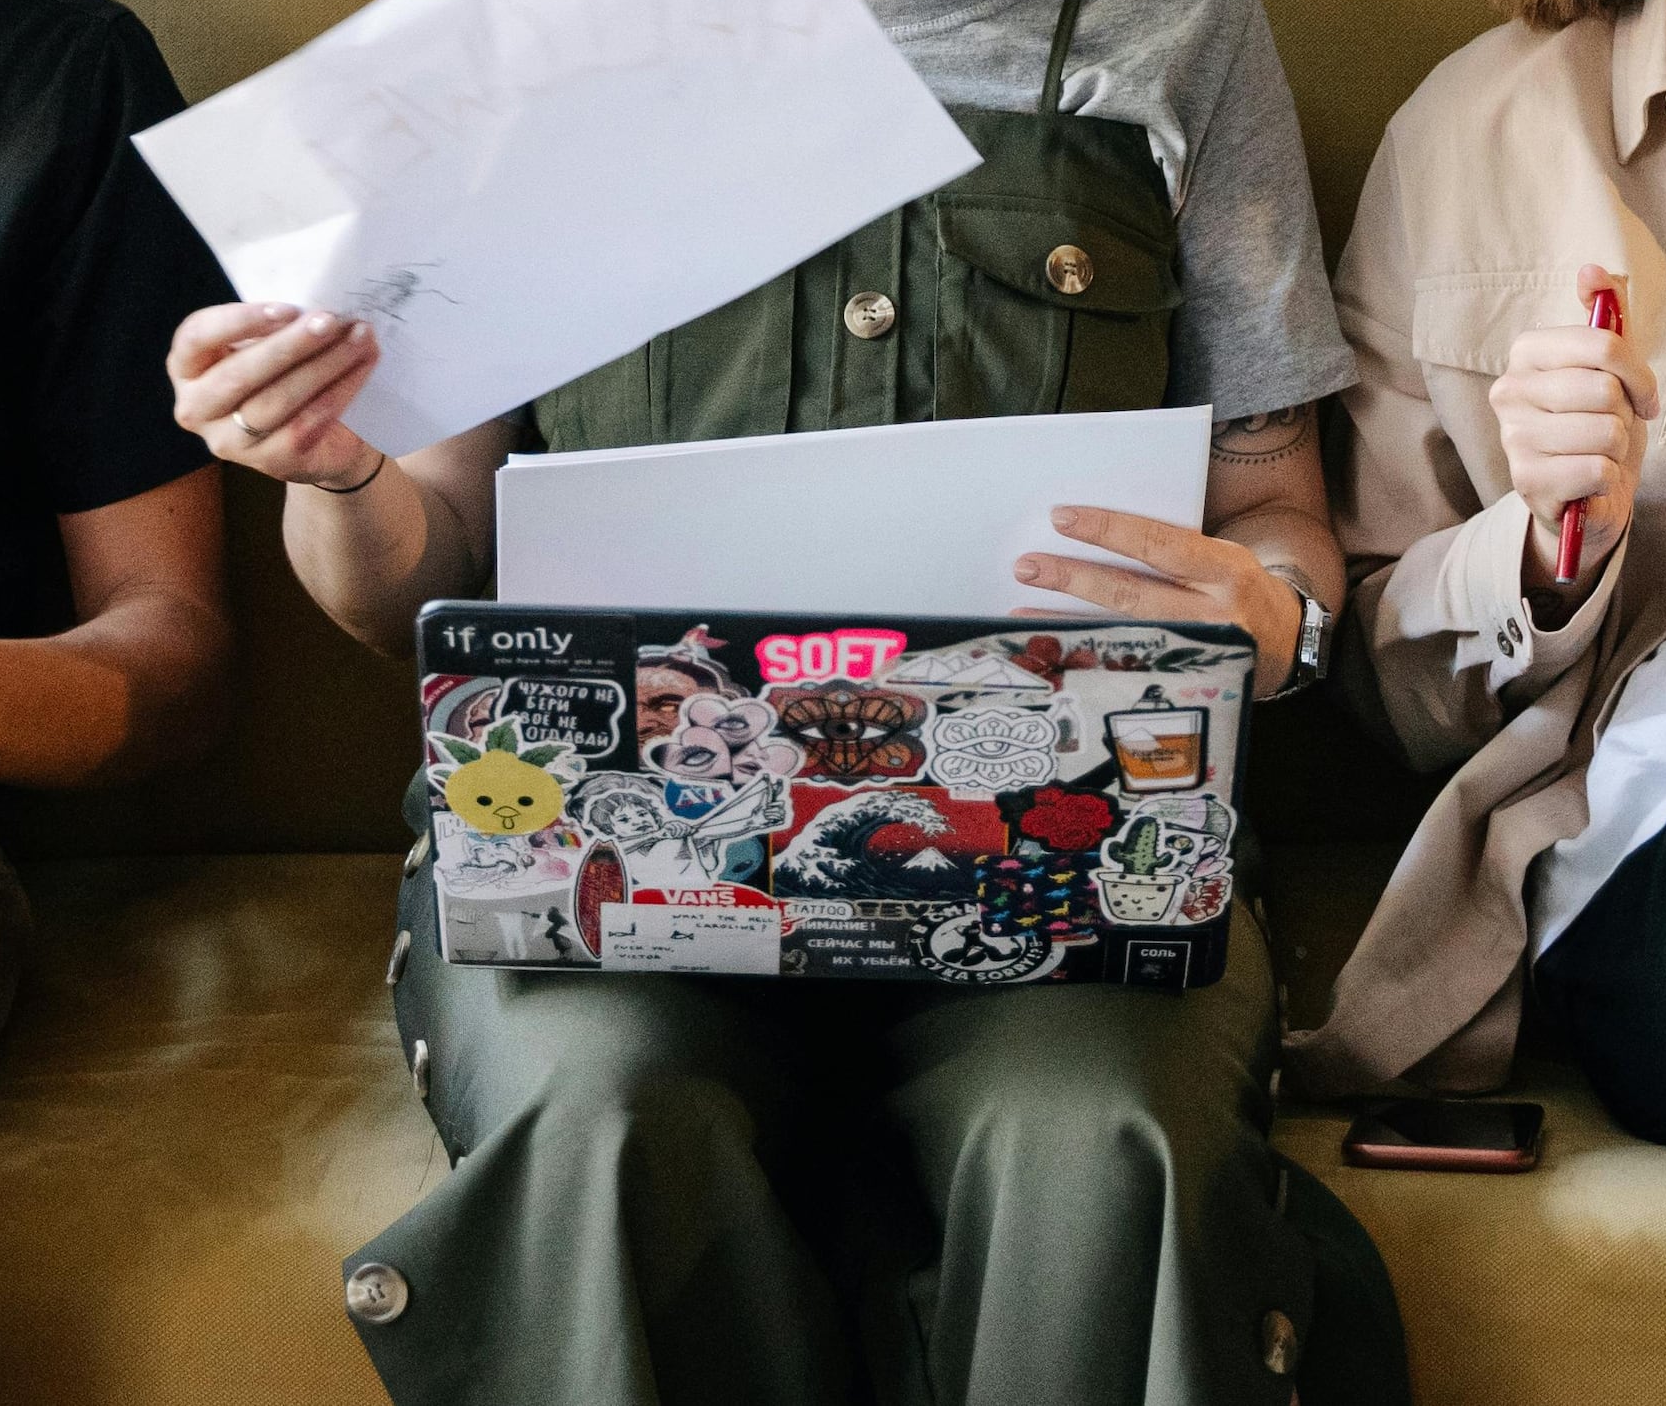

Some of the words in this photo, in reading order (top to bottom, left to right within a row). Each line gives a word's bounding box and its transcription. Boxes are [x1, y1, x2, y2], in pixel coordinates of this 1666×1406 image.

[442, 626, 476, 653] if
[491, 627, 573, 655] only
[764, 636, 898, 679] SOFT
[518, 681, 588, 699] ЧУЖОГО
[595, 689, 614, 703] НЕ
[526, 695, 569, 712] БЕРИ
[558, 716, 578, 730] НЕ
[525, 726, 609, 747] ОТДАВАЙ
[664, 889, 736, 904] VANS
[793, 904, 846, 916] TATTOO
[796, 921, 876, 931] НИМАНИЕ!
[807, 938, 863, 949] СЕЙЧАС
[869, 940, 896, 950] МЫ
[833, 956, 852, 965] ИХ
[920, 957, 969, 980] СУКА
